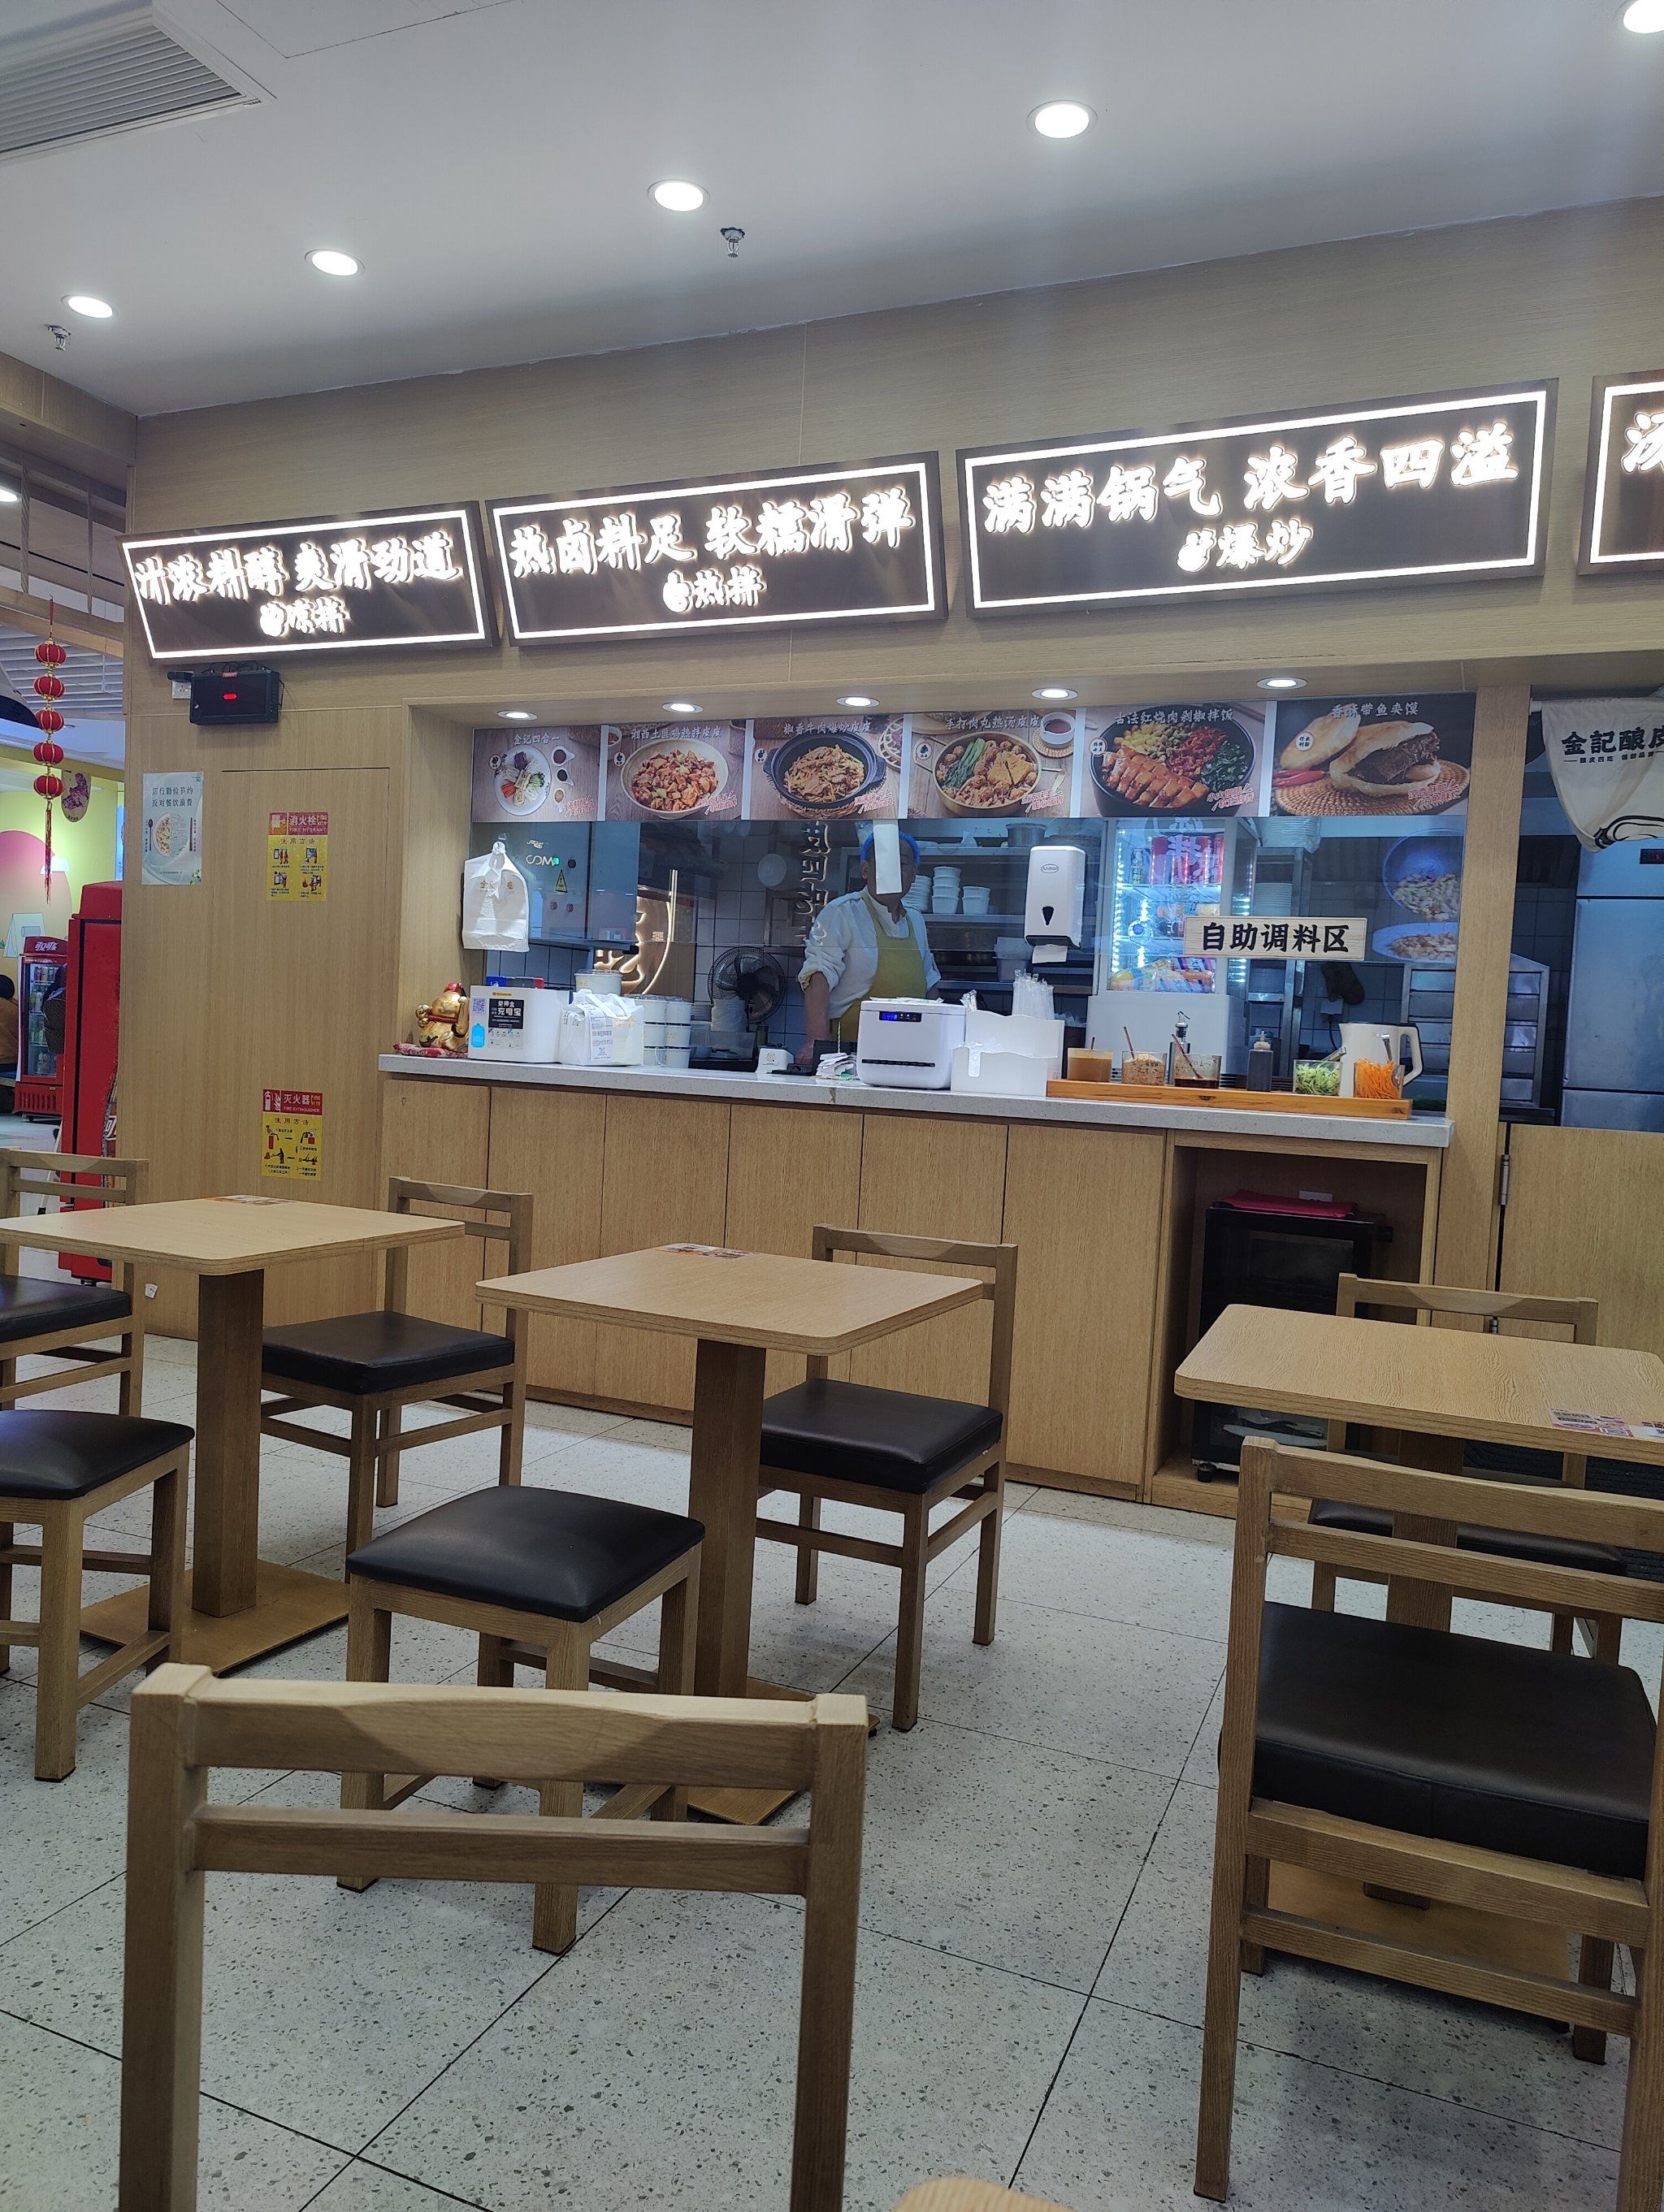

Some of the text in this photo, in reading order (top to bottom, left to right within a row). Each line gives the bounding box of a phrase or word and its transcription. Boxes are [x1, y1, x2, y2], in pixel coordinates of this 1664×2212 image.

[982, 421, 1518, 535] 满满锅气 浓香四溢
[509, 487, 915, 578] 热卤料足 软糯滑弹
[294, 530, 464, 592] 爽滑劲道
[1115, 708, 1234, 725] 古法红烧肉剁椒拌饭
[1331, 701, 1419, 718] 香酥带鱼夹馍
[514, 732, 560, 745] 金记四合一
[152, 786, 193, 795] 厉行勤俭节约
[152, 799, 193, 807] 反对餐饮浪费
[289, 815, 317, 826] 消火栓
[1202, 921, 1350, 952] 自助调料区
[497, 1007, 522, 1016] 充电宝
[283, 1093, 310, 1105] 灭火器
